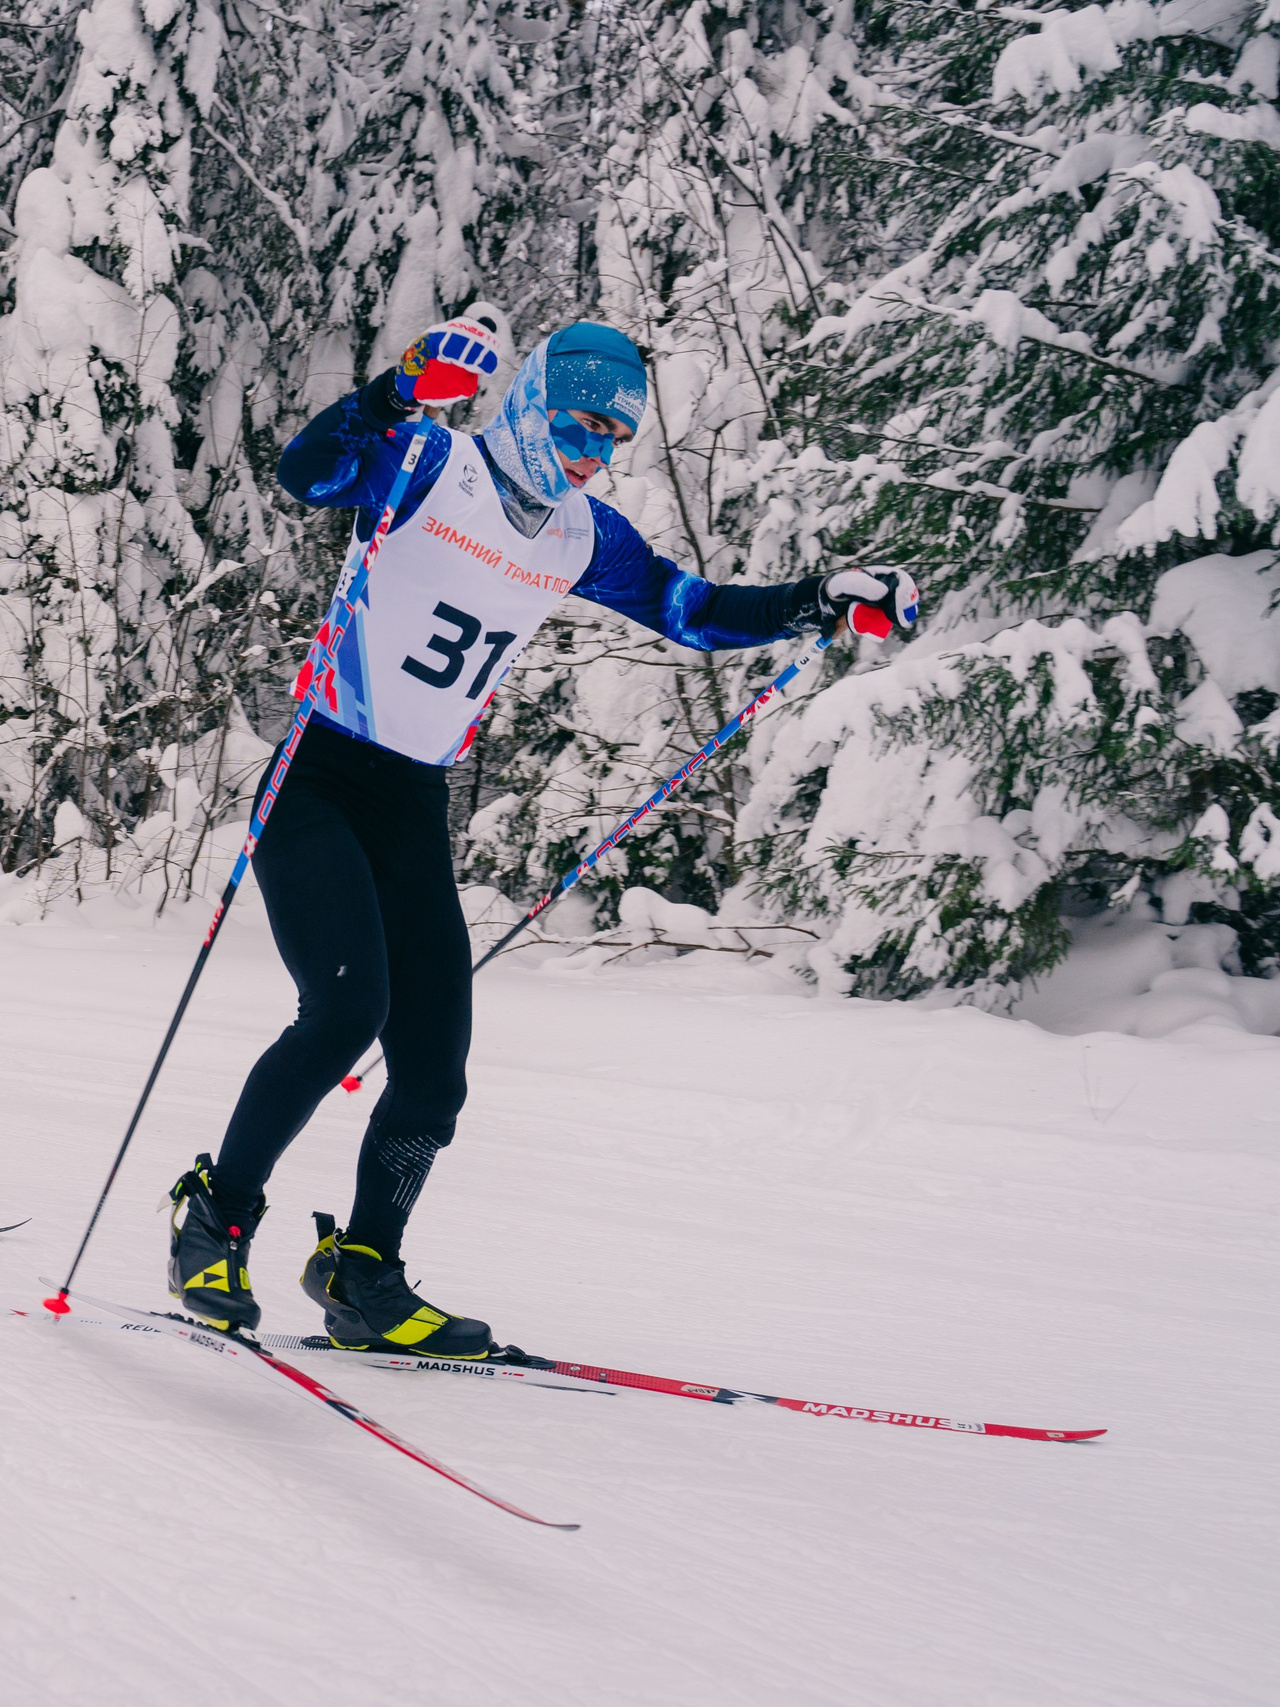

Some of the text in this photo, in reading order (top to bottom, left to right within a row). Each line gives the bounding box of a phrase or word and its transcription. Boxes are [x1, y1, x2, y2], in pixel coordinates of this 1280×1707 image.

[421, 515, 503, 569] ЗИМНИЙ
[400, 600, 518, 700] 31
[189, 1331, 227, 1354] MADSHUS
[416, 1360, 496, 1377] MADSHUS
